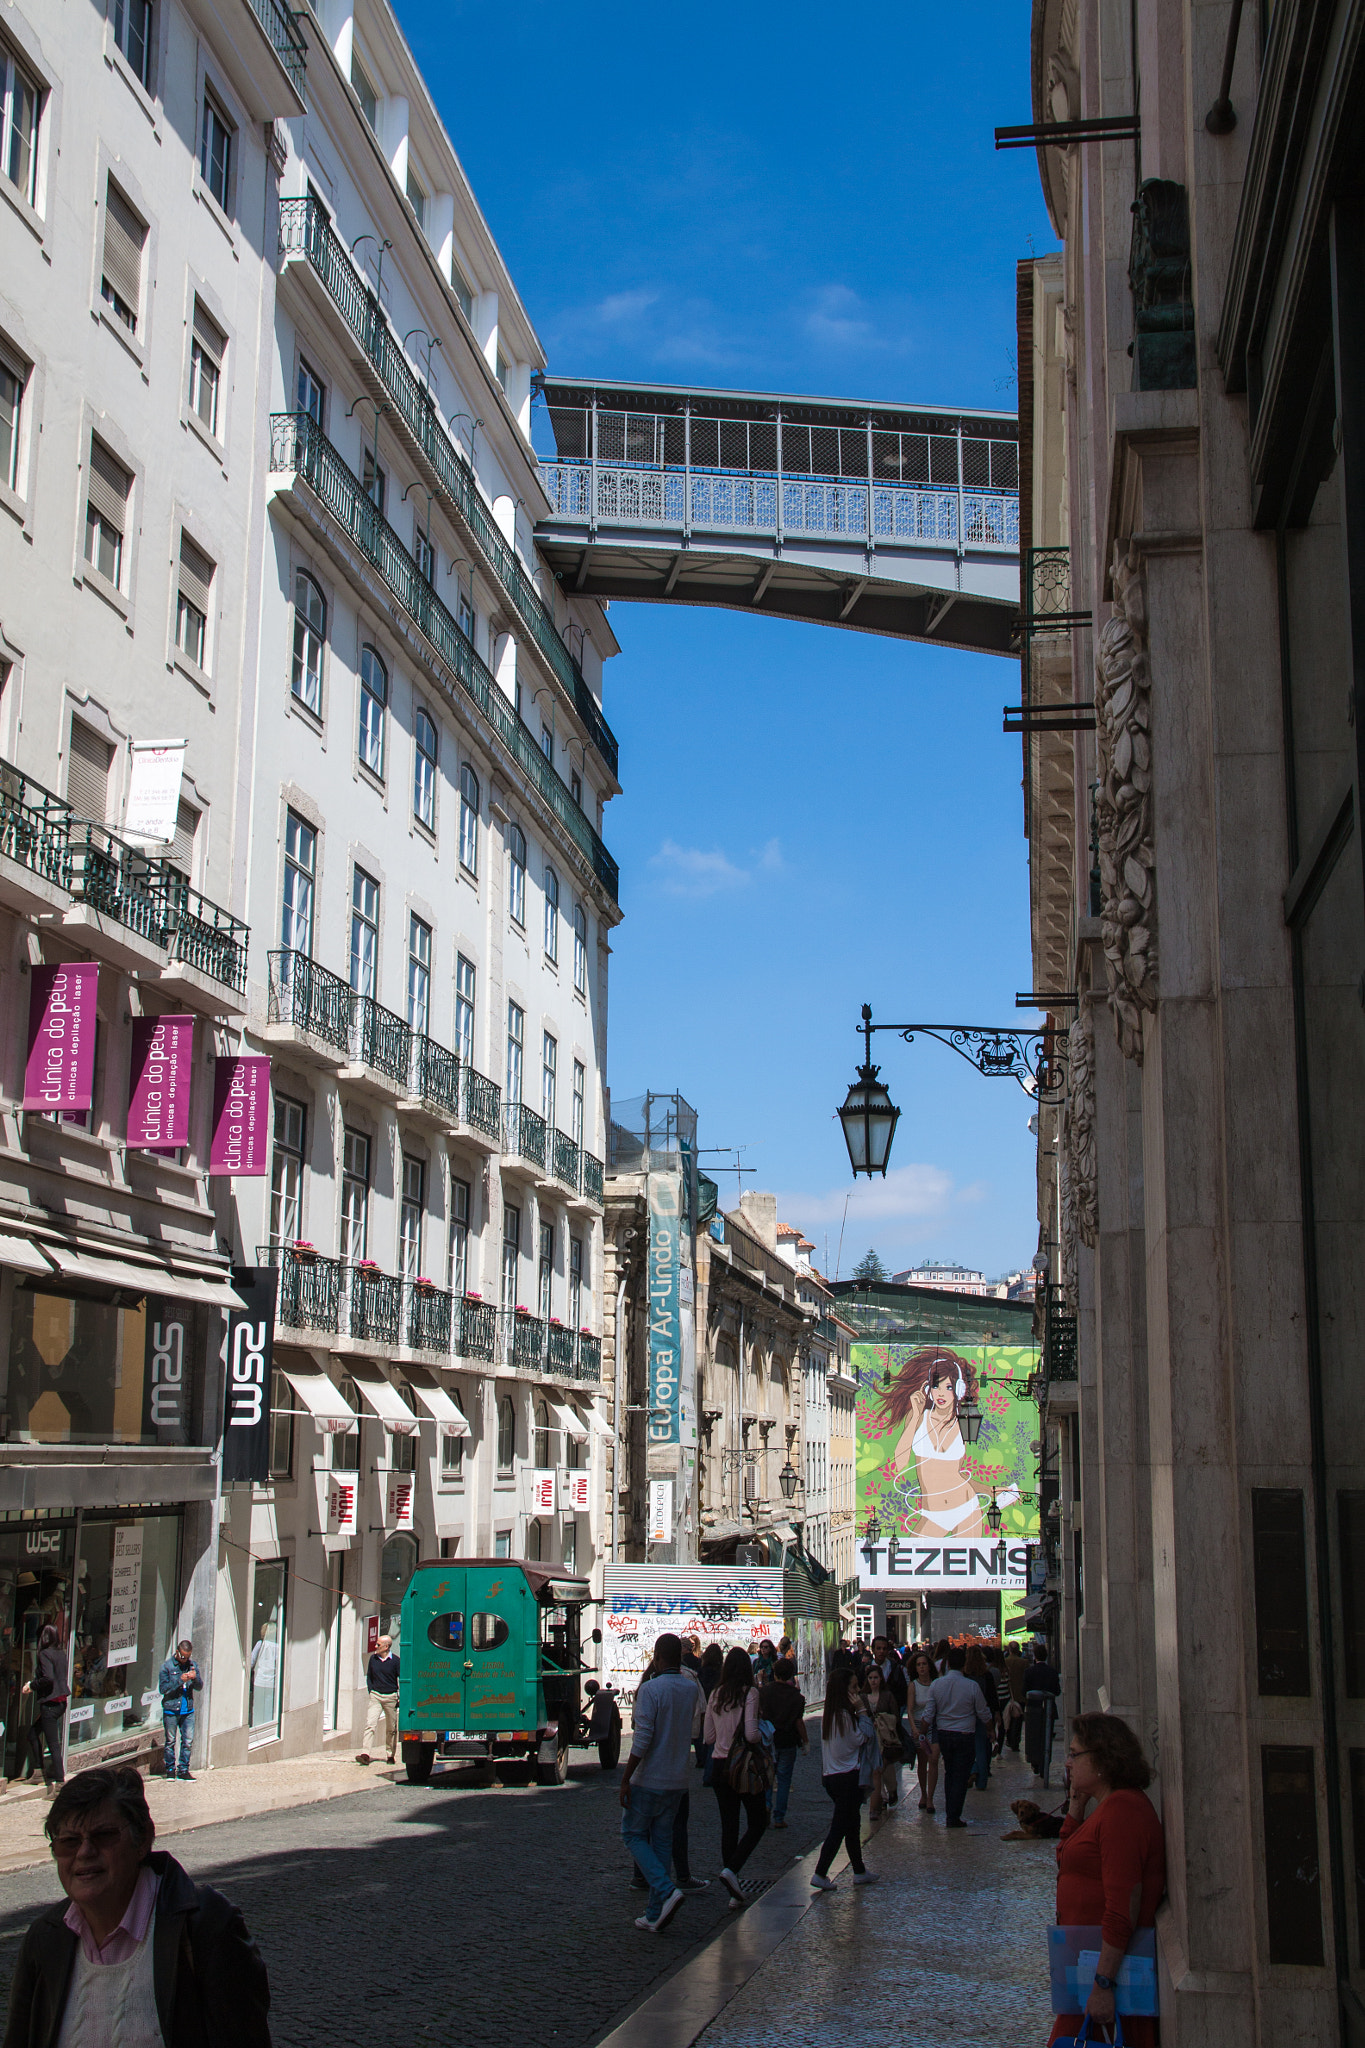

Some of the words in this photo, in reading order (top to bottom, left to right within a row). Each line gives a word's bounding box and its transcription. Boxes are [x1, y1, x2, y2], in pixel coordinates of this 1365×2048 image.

[73, 974, 82, 1000] laser
[43, 1018, 65, 1039] do
[171, 1025, 179, 1049] laser
[143, 1065, 163, 1084] do
[225, 1101, 244, 1118] do
[650, 1230, 673, 1338] Ar-Lindo
[650, 1350, 677, 1441] Europa
[396, 1485, 411, 1520] MUJI
[541, 1480, 552, 1507] MUJI
[577, 1479, 587, 1504] MUJI
[338, 1486, 354, 1524] MUJI
[860, 1548, 1027, 1575] TEZENIS
[429, 1661, 450, 1669] LISBOA
[482, 1661, 504, 1669] LISBOA
